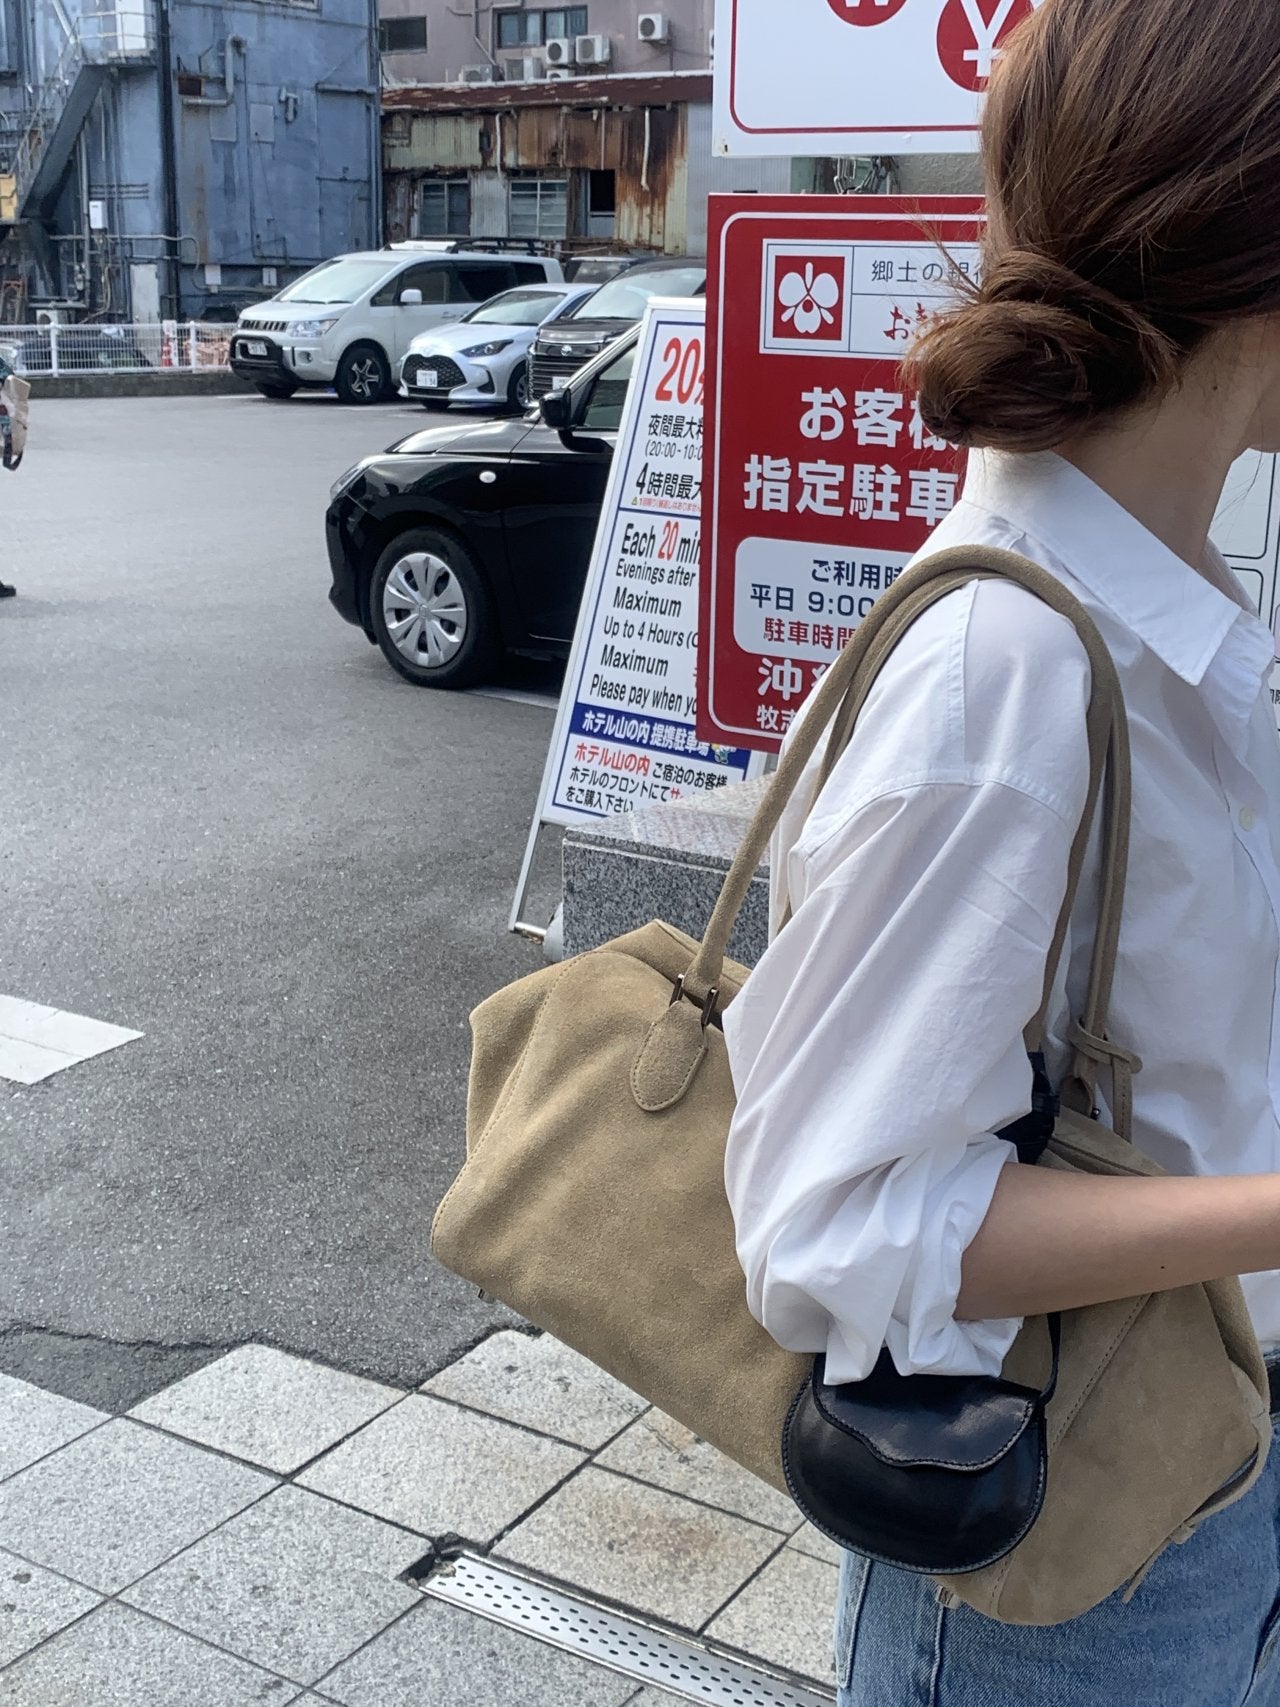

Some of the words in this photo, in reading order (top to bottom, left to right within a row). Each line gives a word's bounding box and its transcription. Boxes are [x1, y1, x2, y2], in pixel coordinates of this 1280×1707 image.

[620, 523, 656, 559] Each
[658, 520, 679, 561] 20
[616, 558, 665, 585] Evenings
[667, 566, 696, 587] after
[613, 586, 682, 618] Maximum
[750, 583, 794, 612] 平日
[603, 615, 619, 639] Up
[623, 621, 635, 639] to
[637, 621, 645, 641] 4
[647, 623, 685, 648] Hours
[600, 644, 669, 677] Maximum
[589, 673, 627, 704] Please
[628, 681, 650, 708] pay
[652, 685, 683, 713] when
[758, 657, 827, 701] 沖
[582, 709, 650, 744] ホテル山の内
[574, 742, 650, 777] ホテル山の内
